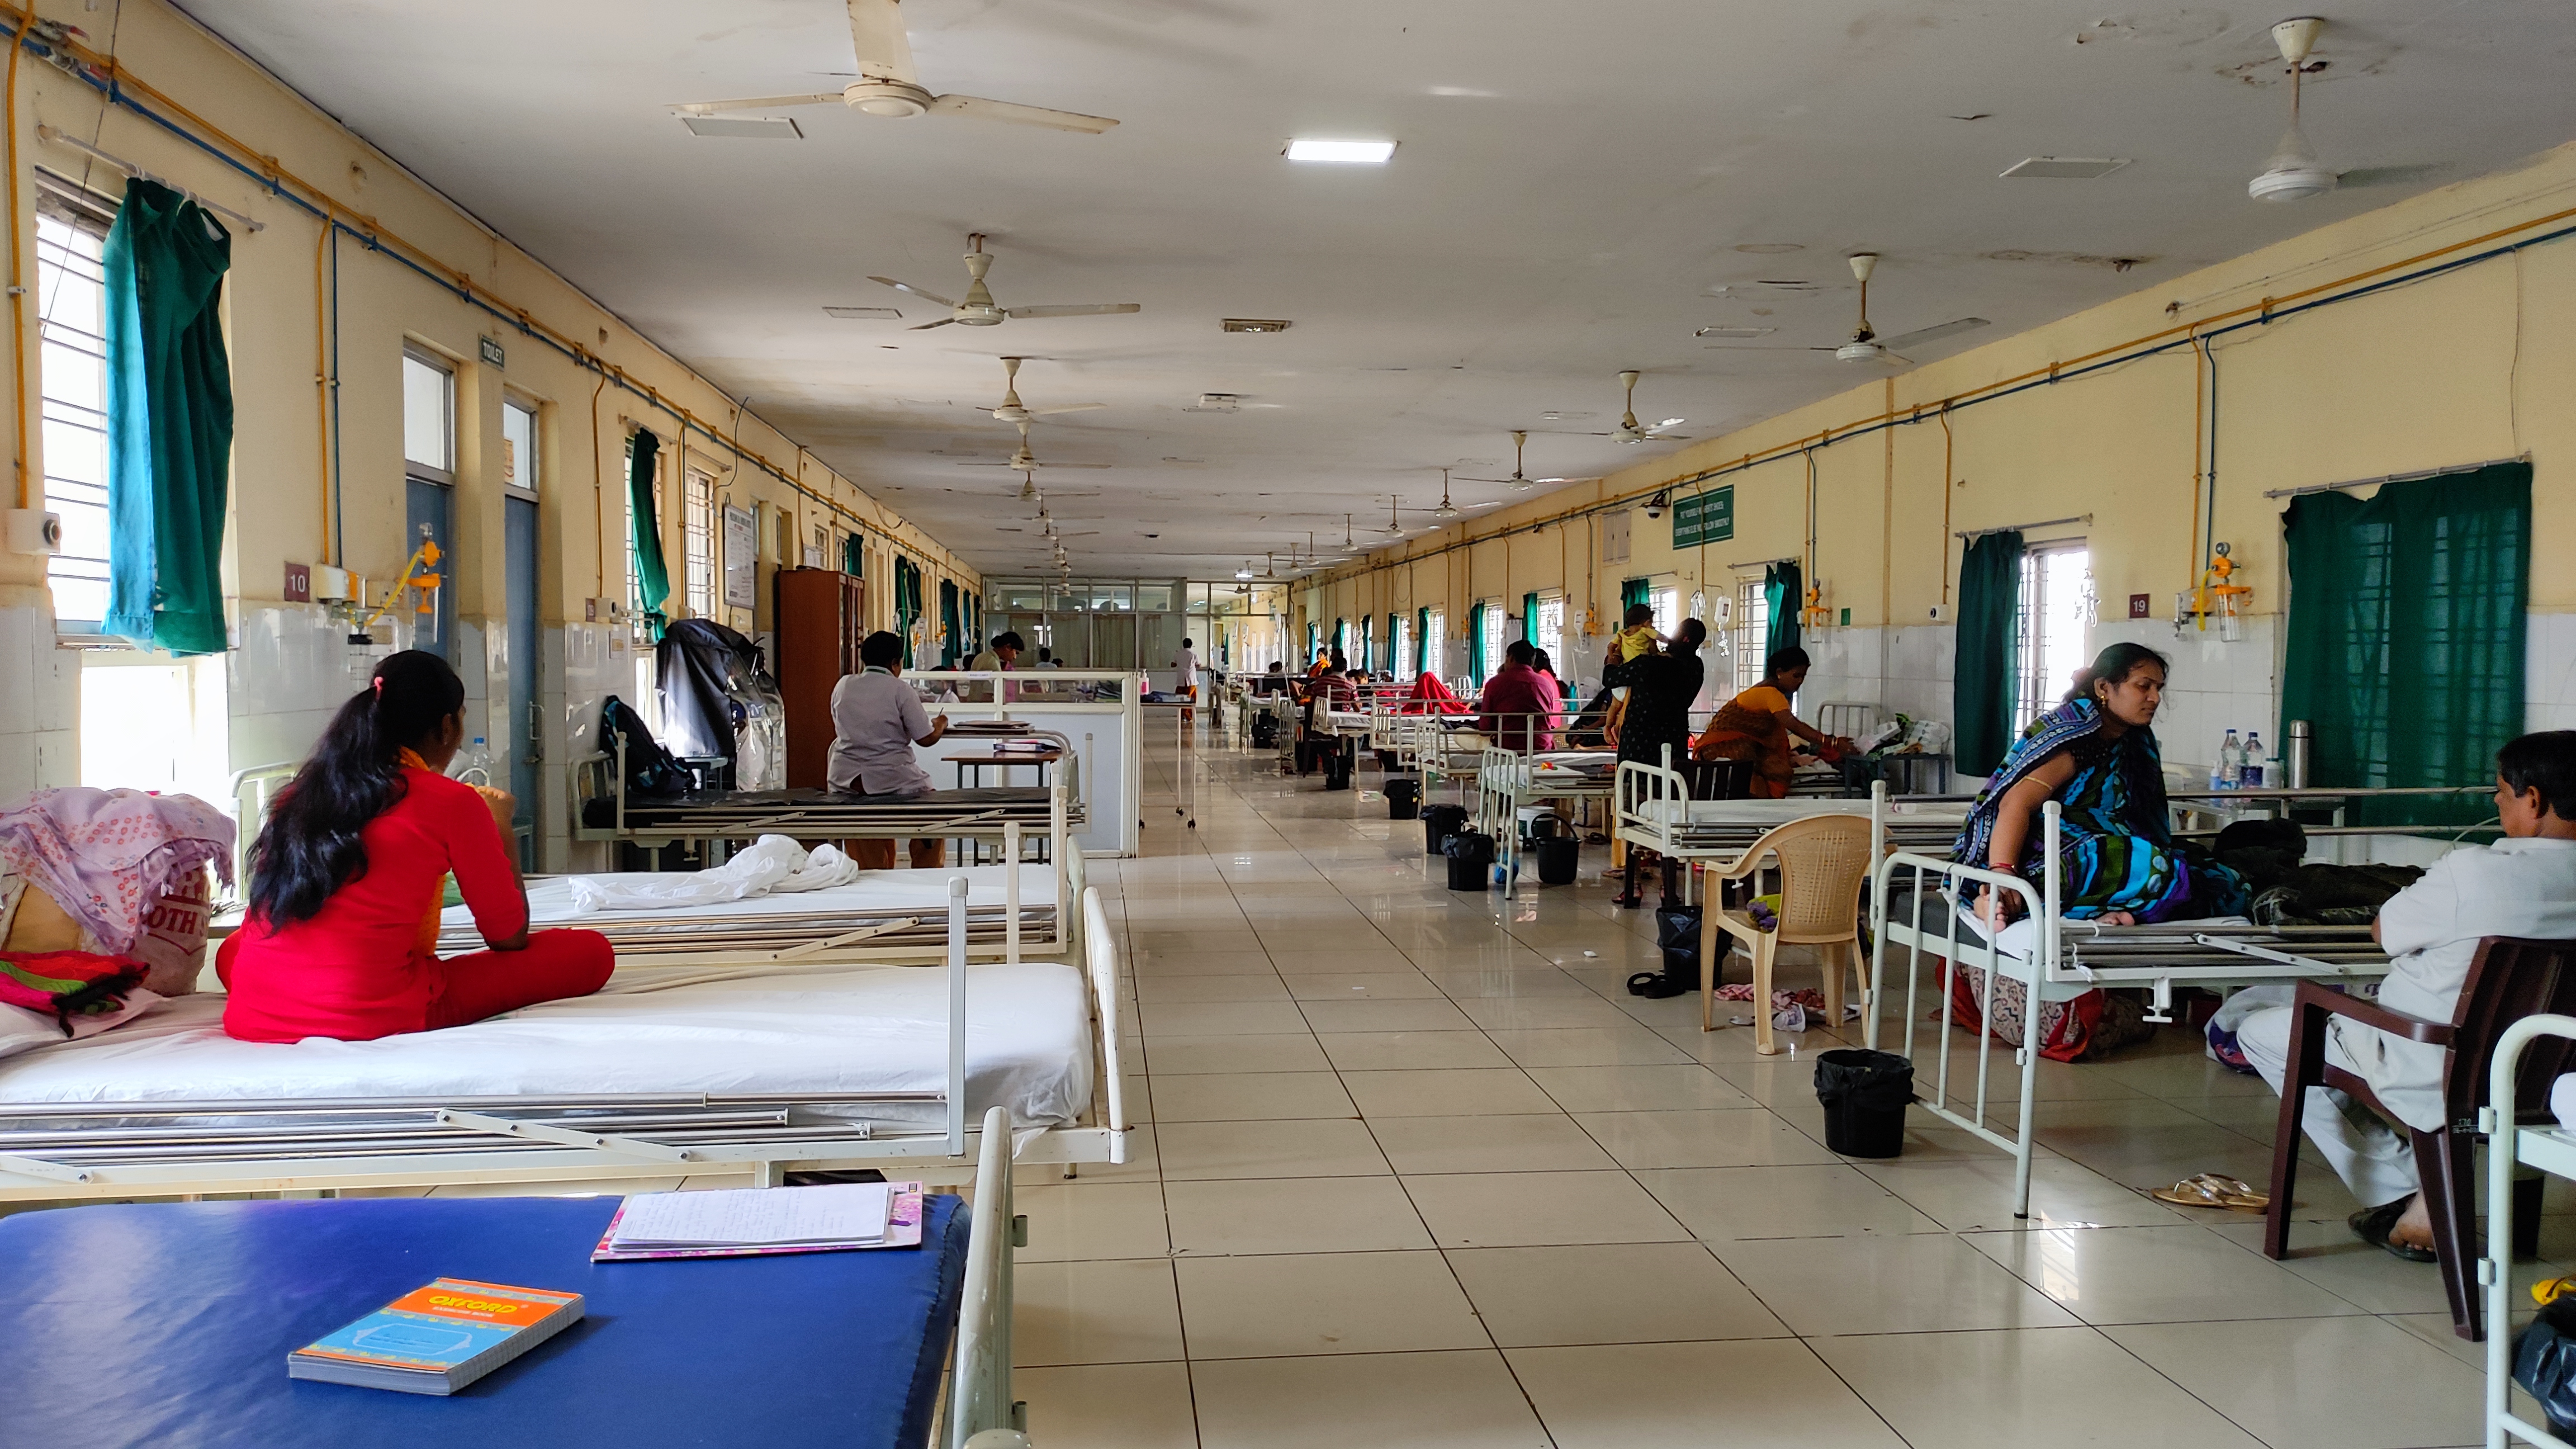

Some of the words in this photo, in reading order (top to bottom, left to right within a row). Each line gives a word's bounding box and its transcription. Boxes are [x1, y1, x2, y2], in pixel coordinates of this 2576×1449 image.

[483, 341, 503, 363] TOILET
[290, 574, 306, 593] 10
[2133, 599, 2146, 612] 19
[140, 905, 198, 935] OTH
[428, 1295, 518, 1313] OXFORD
